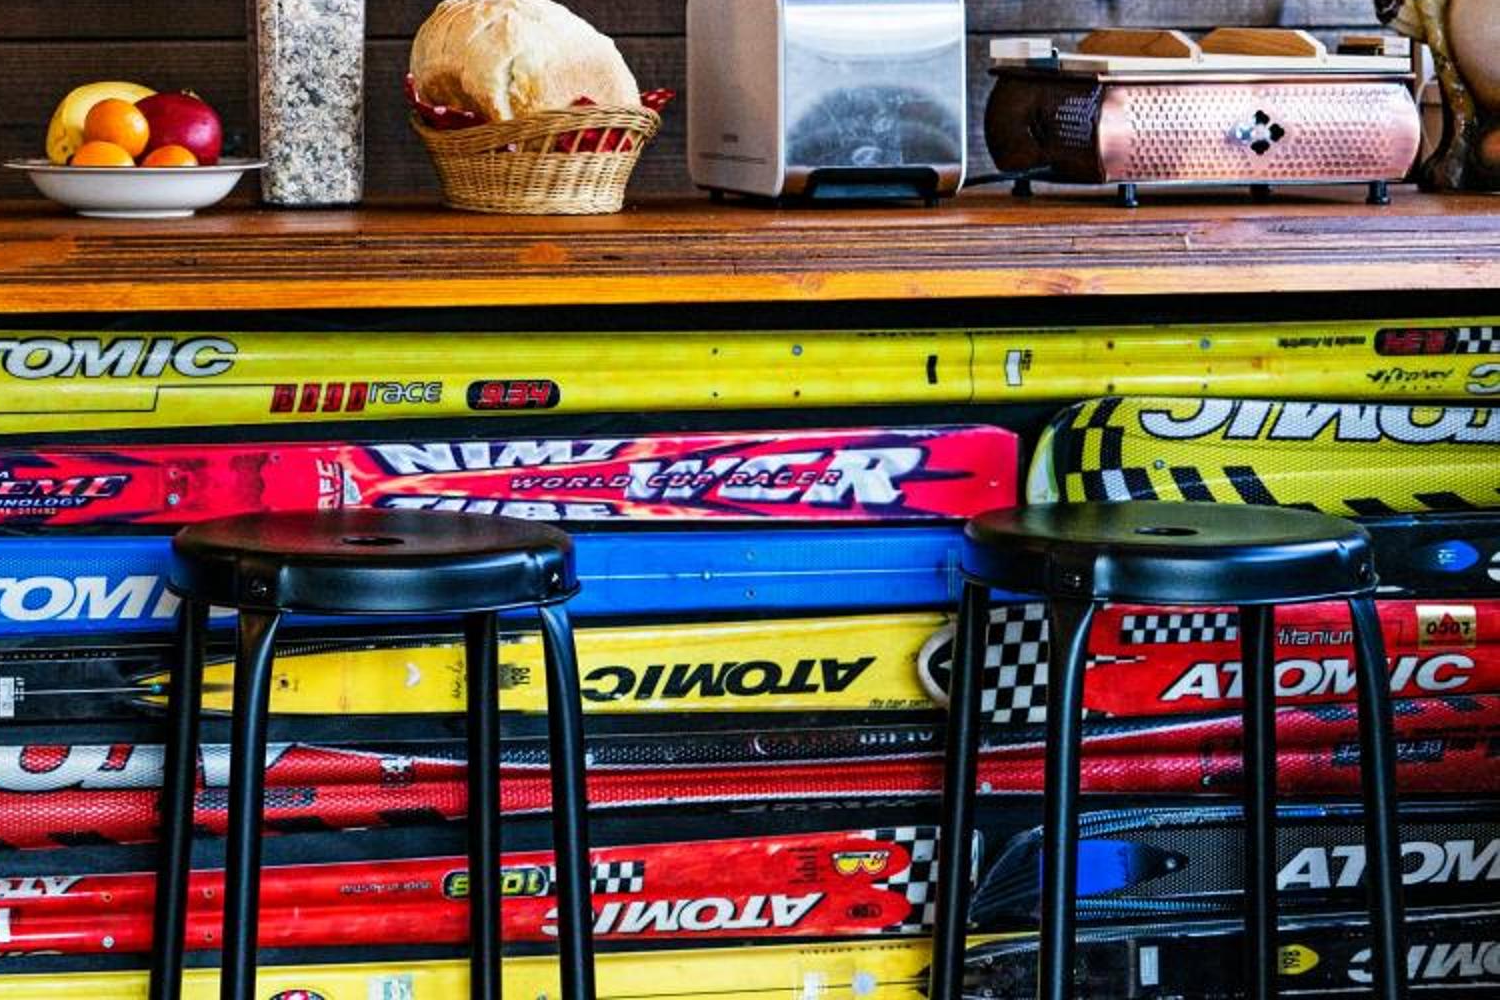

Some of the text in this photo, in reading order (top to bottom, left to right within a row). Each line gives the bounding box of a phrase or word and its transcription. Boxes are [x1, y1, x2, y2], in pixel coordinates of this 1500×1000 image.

[511, 470, 841, 490] WORLD CUP RACER
[624, 448, 923, 504] WCR
[580, 655, 878, 702] ATOMIC
[1277, 838, 1500, 890] ATOM
